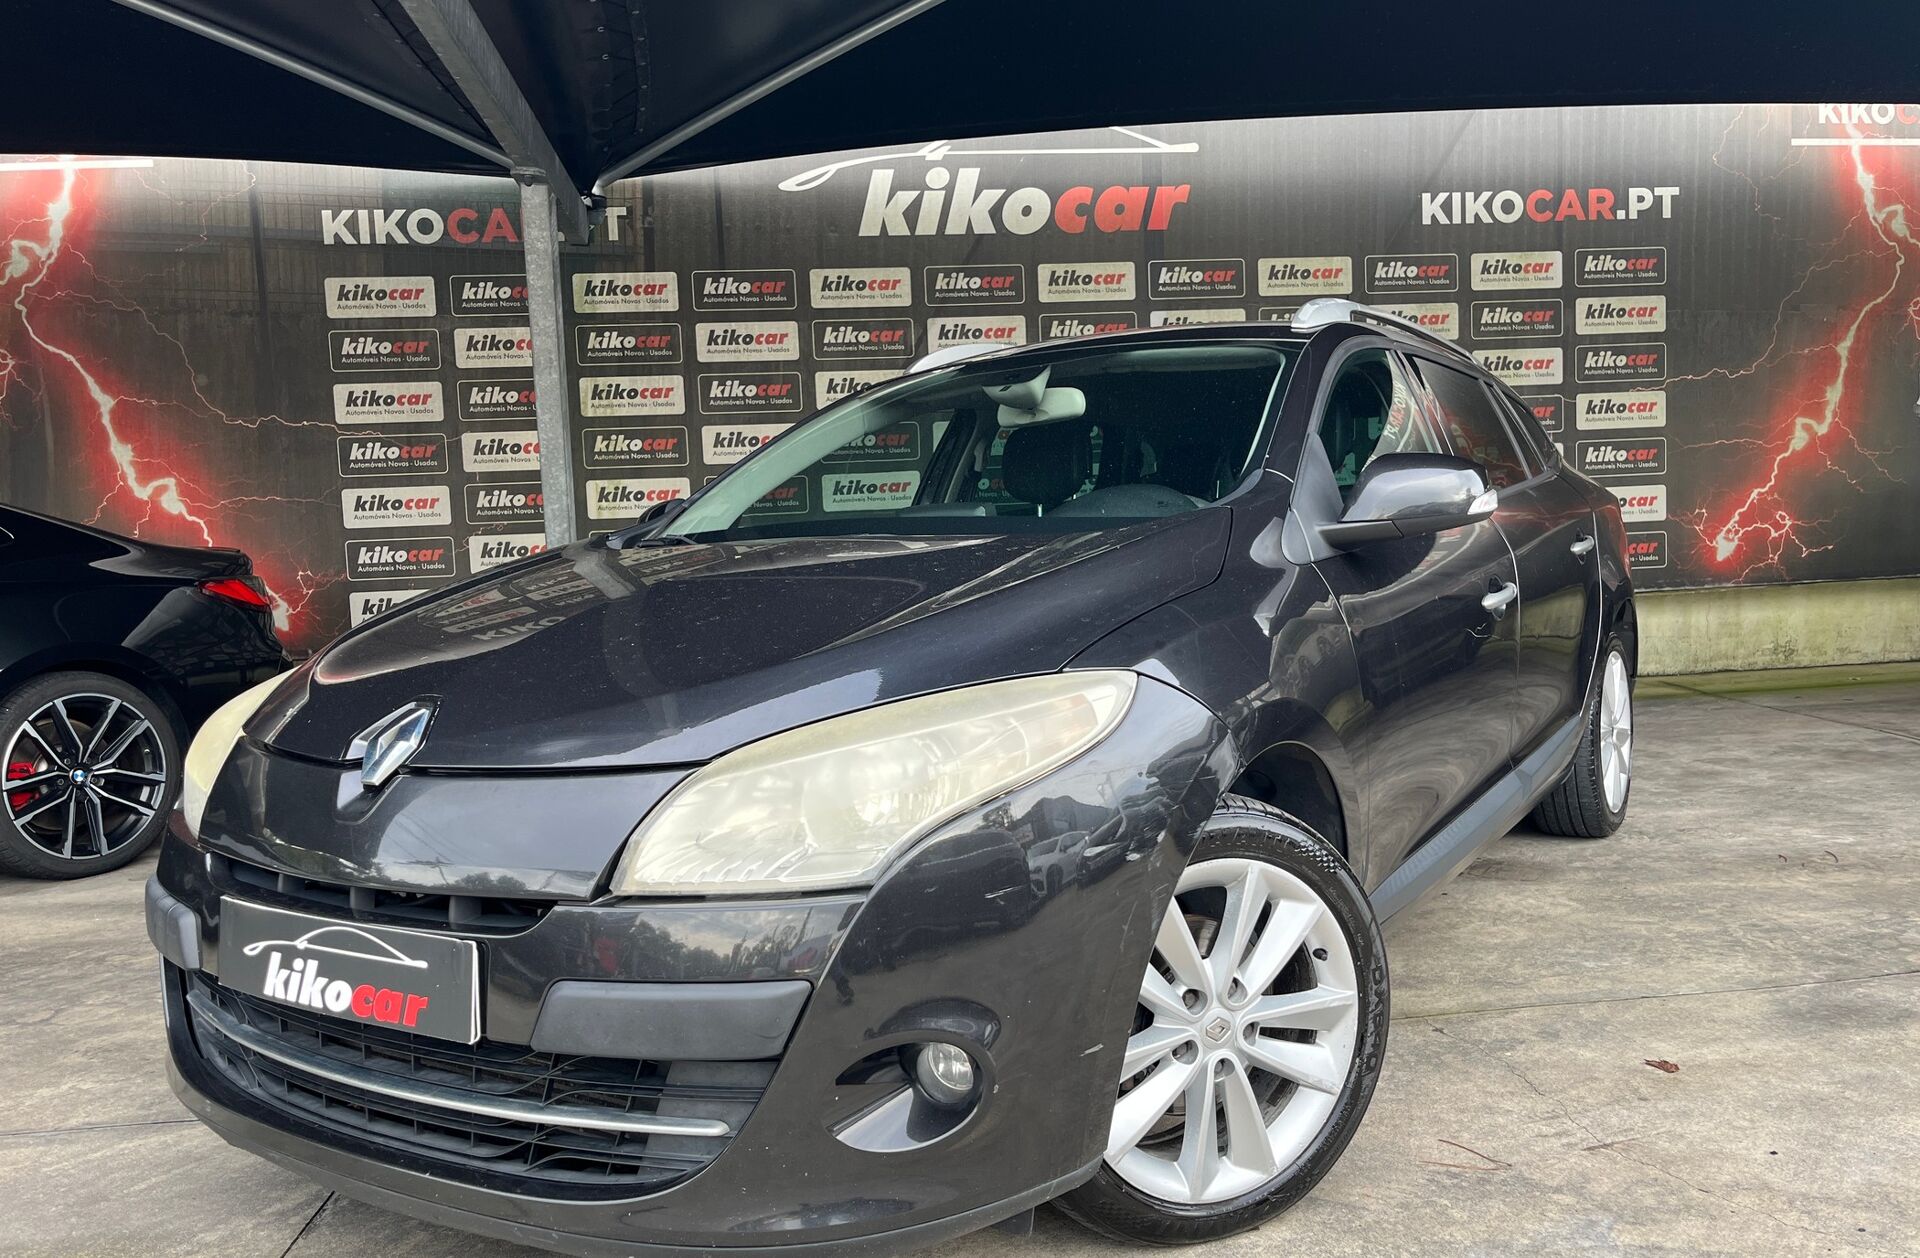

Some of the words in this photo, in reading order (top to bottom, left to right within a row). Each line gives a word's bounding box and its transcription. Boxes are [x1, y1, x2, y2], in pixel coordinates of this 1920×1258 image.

[858, 167, 1190, 236] kikocar
[1422, 187, 1680, 225] KIKOCAR.PT
[1375, 262, 1449, 278] kikocar
[1480, 259, 1554, 275] kikocar
[1584, 255, 1658, 271] kikocar
[1048, 270, 1126, 286] kikocar
[1158, 267, 1237, 283] kikocar
[1267, 264, 1343, 280] kikocar
[584, 280, 668, 297] kikocar
[703, 277, 786, 294] kikocar
[820, 275, 901, 292] kikocar
[935, 272, 1014, 290] kikocar
[337, 284, 425, 301] kikocar
[1480, 307, 1554, 324] kikocar
[1584, 303, 1658, 319] kikocar
[587, 332, 670, 349] kikocar
[706, 329, 789, 346] kikocar
[823, 326, 904, 343] kikocar
[938, 324, 1016, 340] kikocar
[341, 337, 429, 355] kikocar
[1484, 356, 1554, 371] kikocar
[1585, 351, 1658, 367] kikocar
[590, 384, 674, 400] kikocar
[709, 380, 791, 397] kikocar
[345, 390, 432, 407] kikocar
[1585, 399, 1658, 415] kikocar
[350, 442, 437, 460] kikocar
[594, 435, 678, 452] kikocar
[1585, 446, 1657, 462] kikocar
[598, 486, 680, 502] kikocar
[832, 480, 911, 496] kikocar
[354, 495, 440, 512] kikocar
[358, 546, 444, 564] kikocar
[264, 952, 429, 1026] kikocar
